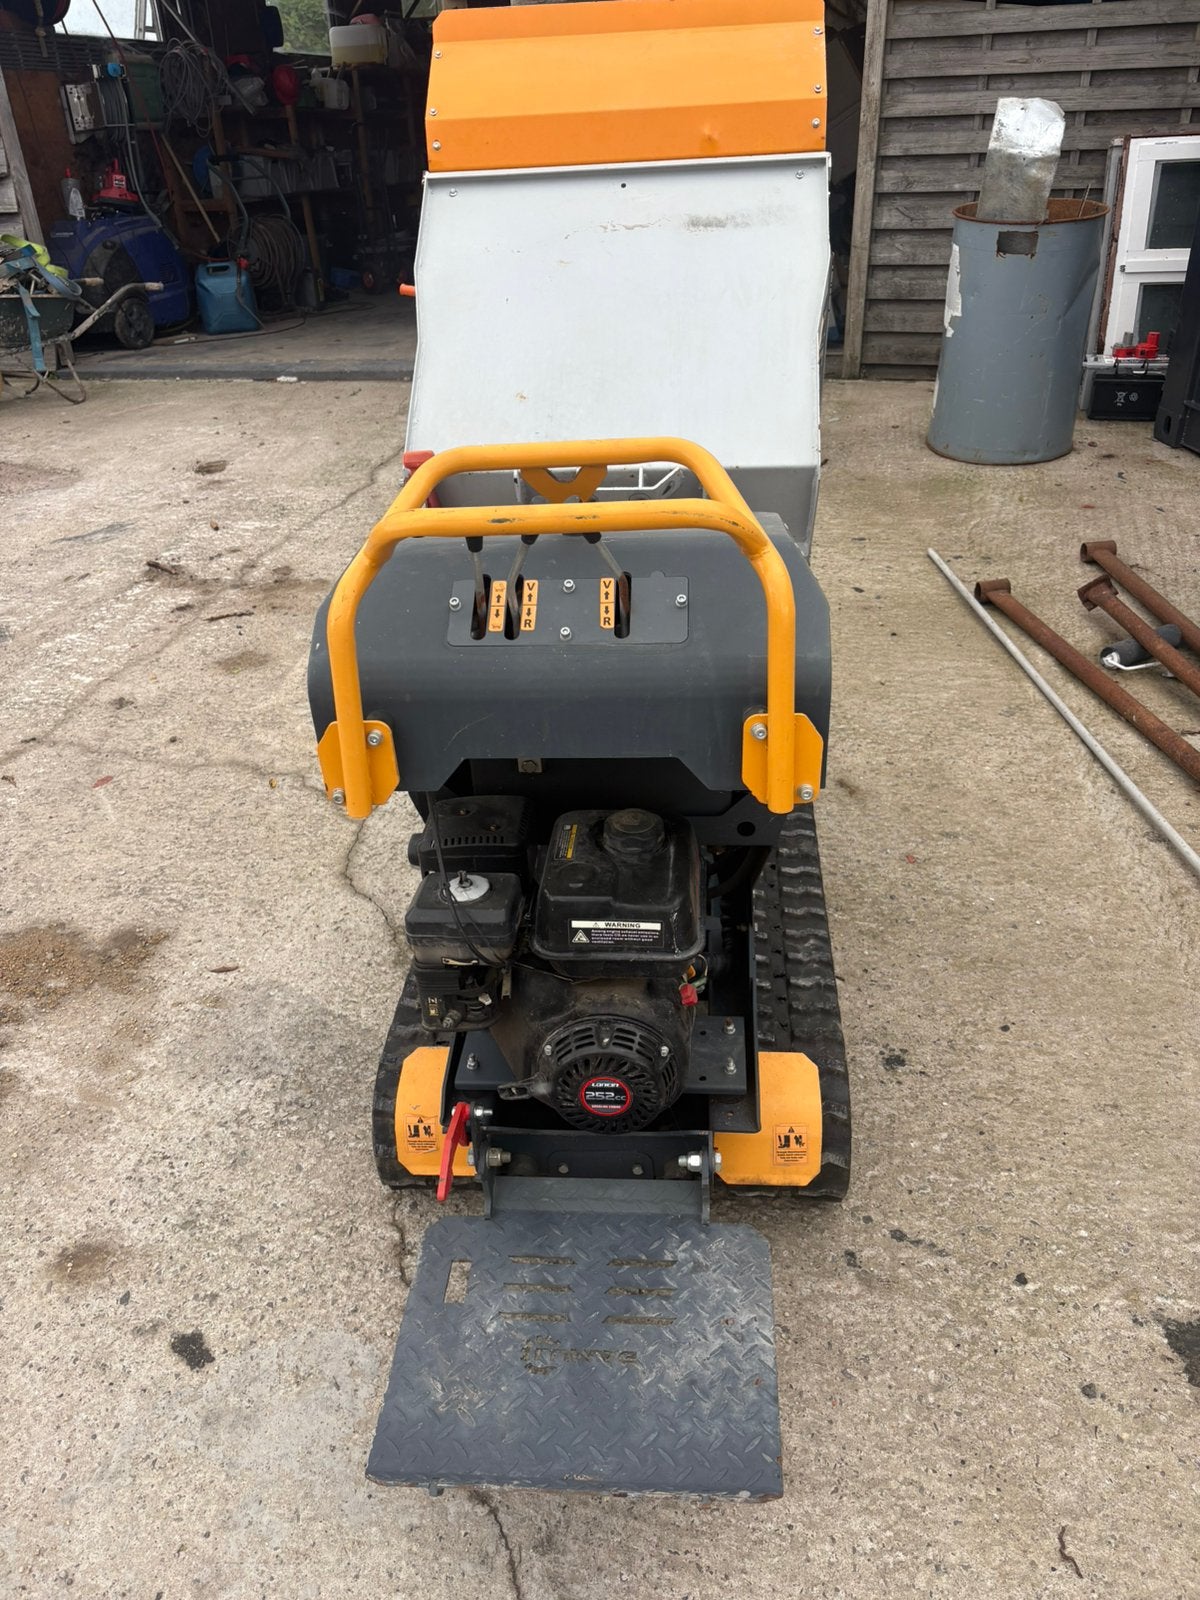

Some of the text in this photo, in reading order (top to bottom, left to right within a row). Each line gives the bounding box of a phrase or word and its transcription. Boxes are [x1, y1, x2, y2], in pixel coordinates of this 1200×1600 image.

[526, 582, 536, 591] V
[603, 580, 612, 589] V
[523, 619, 532, 628] R
[603, 617, 611, 626] R
